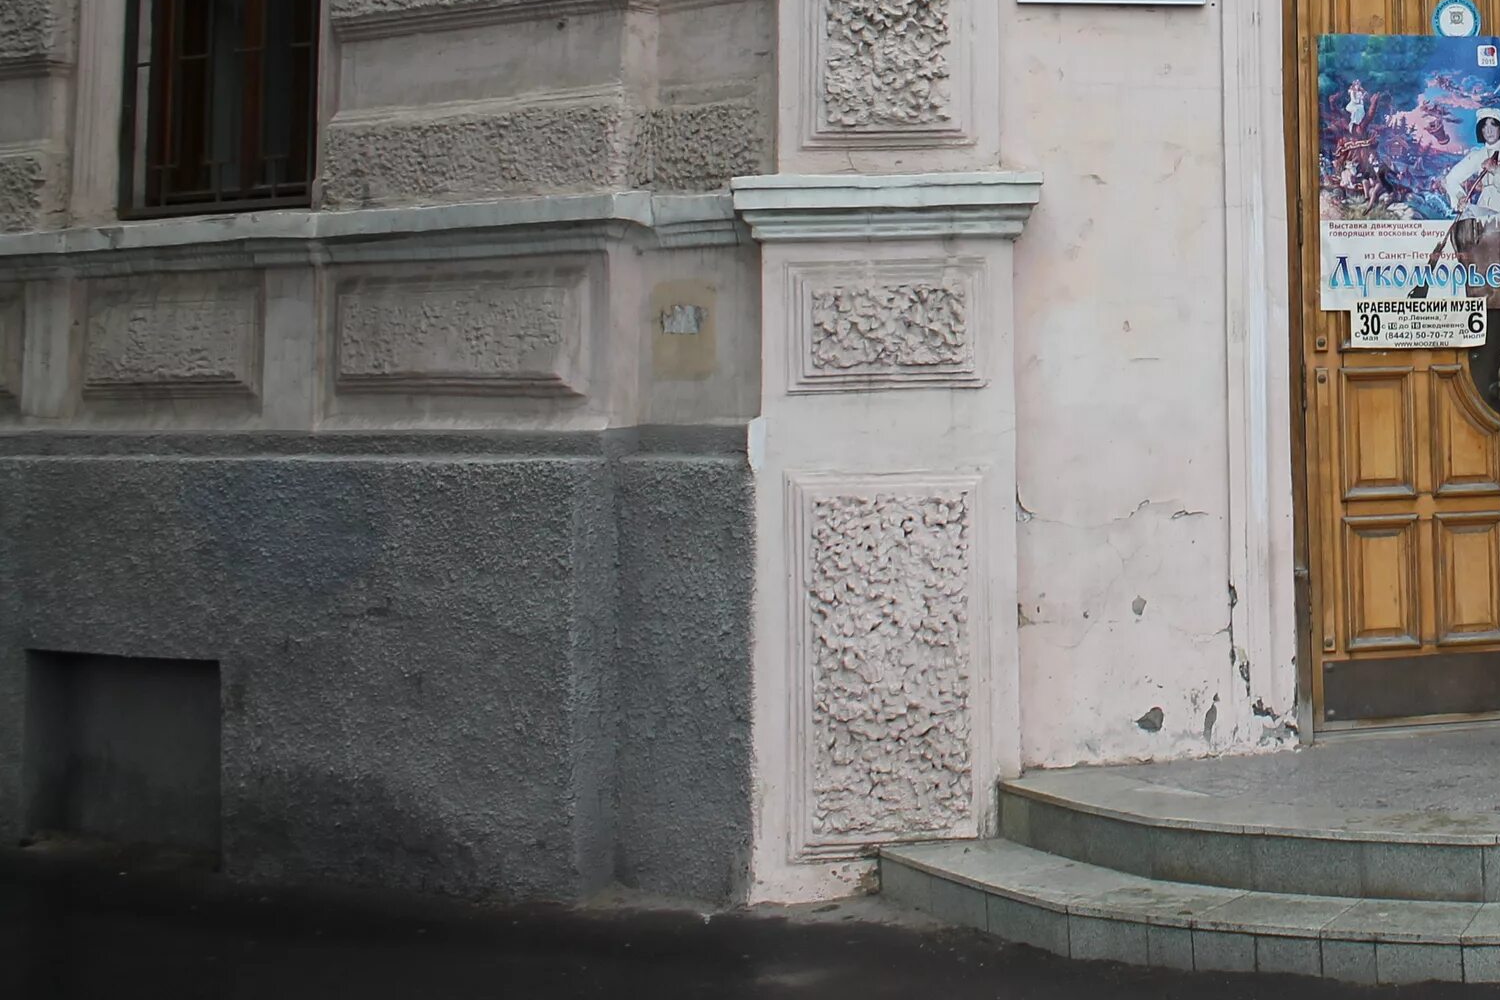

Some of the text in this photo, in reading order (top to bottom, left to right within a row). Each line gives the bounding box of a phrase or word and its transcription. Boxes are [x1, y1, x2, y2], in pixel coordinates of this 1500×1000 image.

[1370, 223, 1422, 231] движущихся
[1420, 229, 1445, 238] фигур
[1357, 299, 1484, 314] КРАЕВЕДЧЕСКИЙ МУЗЕЙ
[1360, 314, 1380, 335] 30
[1468, 312, 1484, 333] 6
[1385, 331, 1454, 340] (8442) 50-70-72
